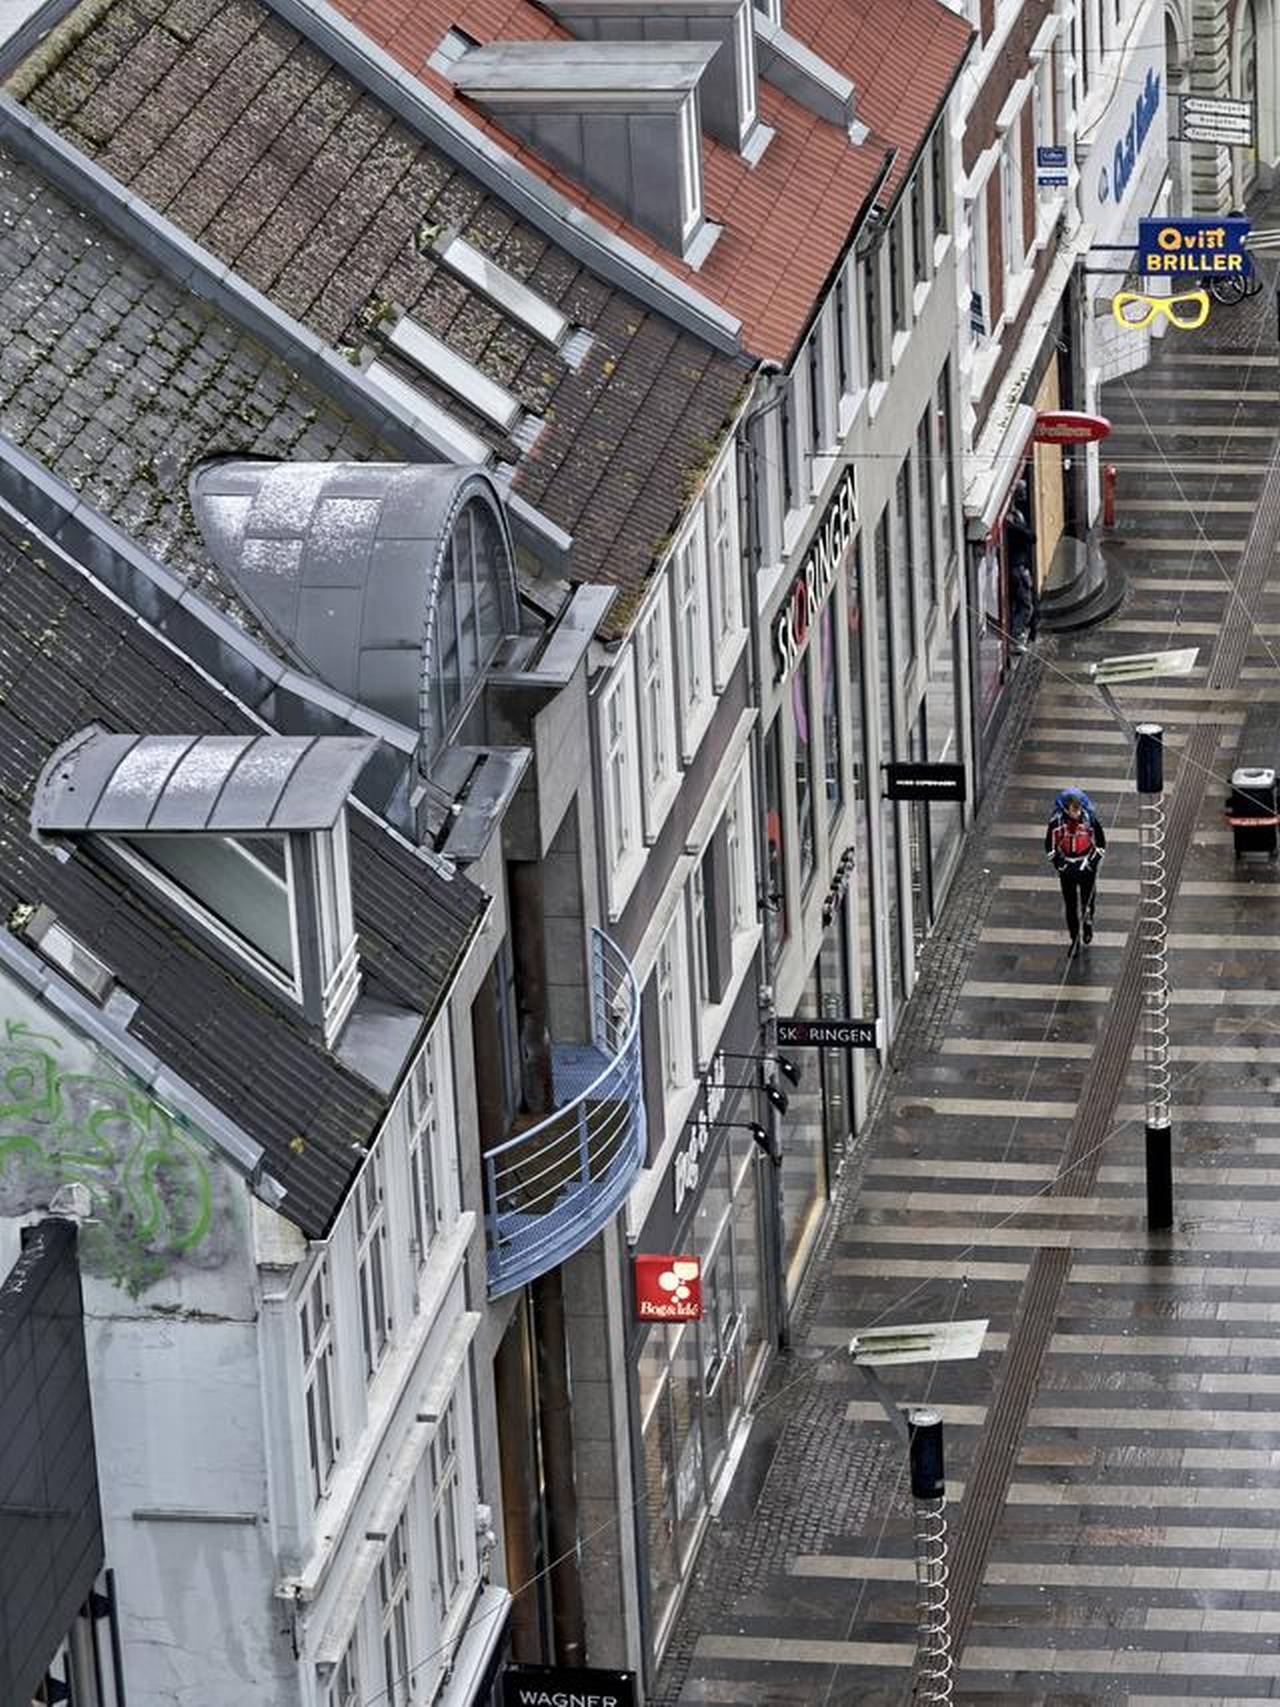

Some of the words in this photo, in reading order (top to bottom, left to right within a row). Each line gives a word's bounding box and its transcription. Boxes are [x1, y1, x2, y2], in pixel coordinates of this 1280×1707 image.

[1157, 227, 1227, 251] Qvist
[1146, 254, 1243, 273] BRILLER
[778, 1026, 873, 1043] SKRINGEN
[519, 1689, 617, 1707] WAGNER
